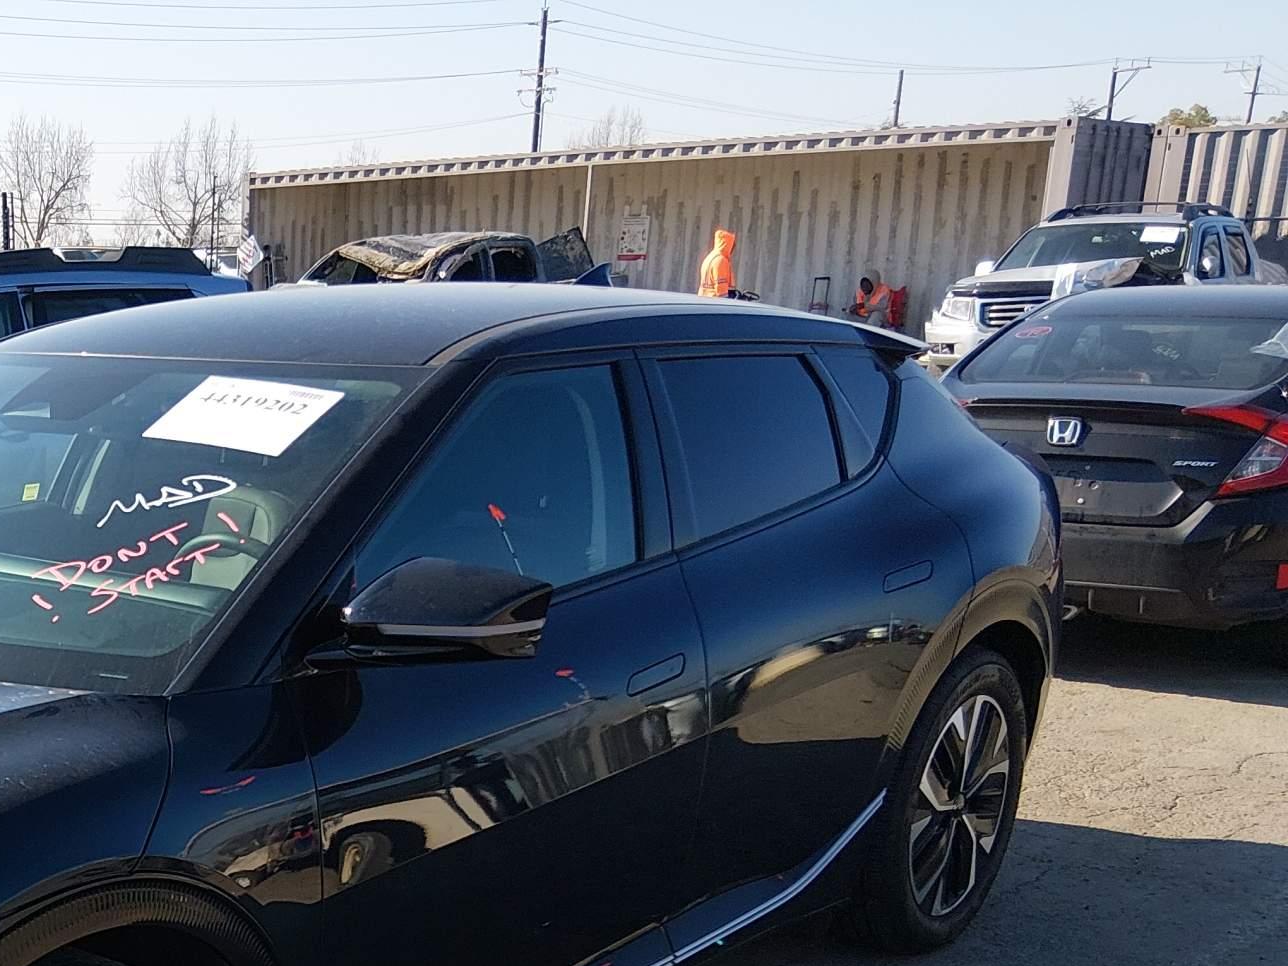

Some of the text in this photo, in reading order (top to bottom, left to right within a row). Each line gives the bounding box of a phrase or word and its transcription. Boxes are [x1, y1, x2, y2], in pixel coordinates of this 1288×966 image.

[1150, 246, 1176, 258] MAD
[96, 474, 238, 528] MAD
[86, 542, 221, 615] START
